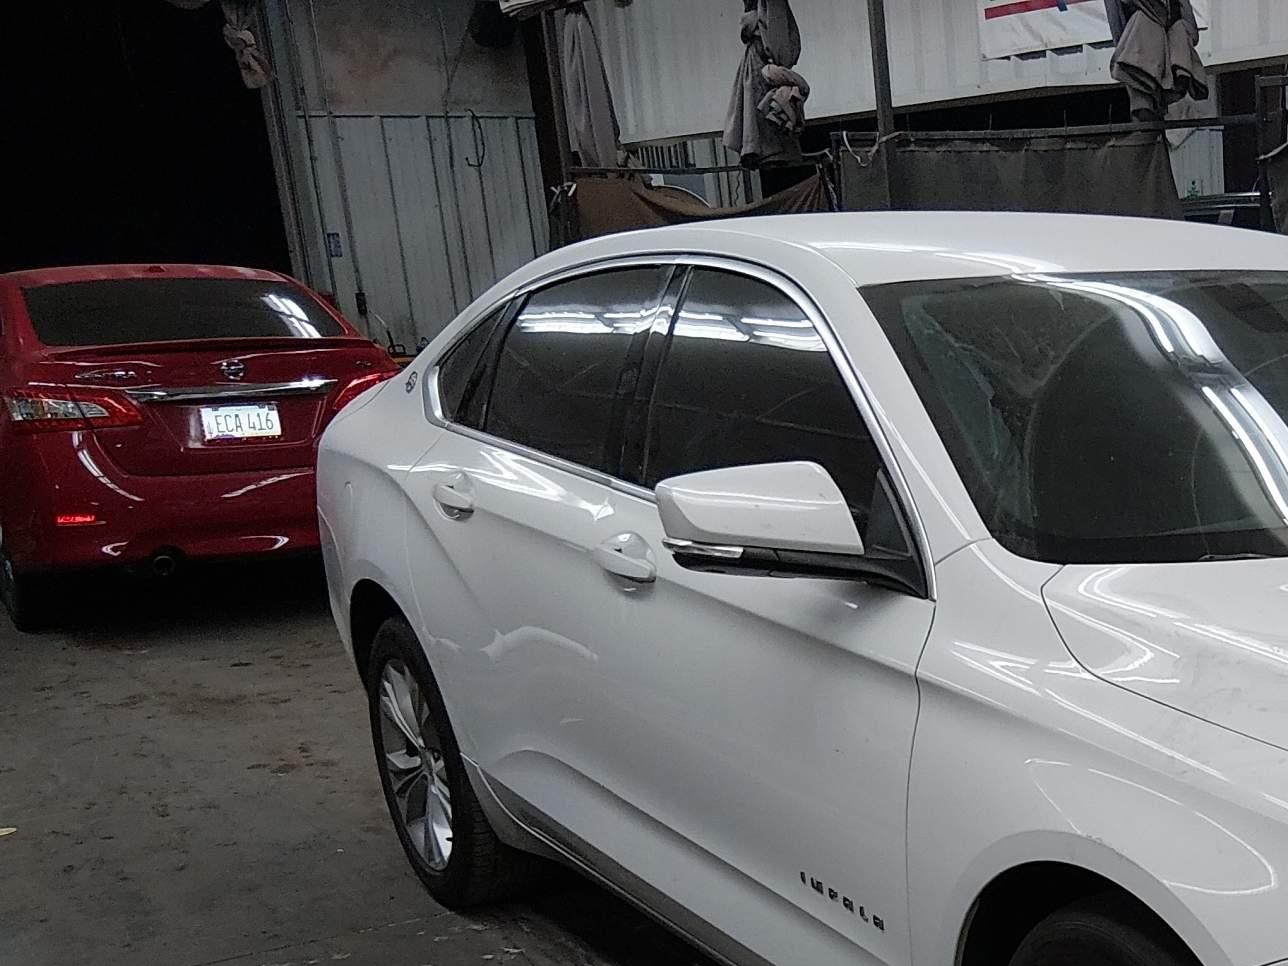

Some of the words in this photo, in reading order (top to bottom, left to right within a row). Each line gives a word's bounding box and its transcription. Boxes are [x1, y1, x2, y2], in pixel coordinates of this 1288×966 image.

[214, 414, 244, 433] ECA
[247, 412, 274, 431] 416
[799, 871, 885, 932] IMPALA
